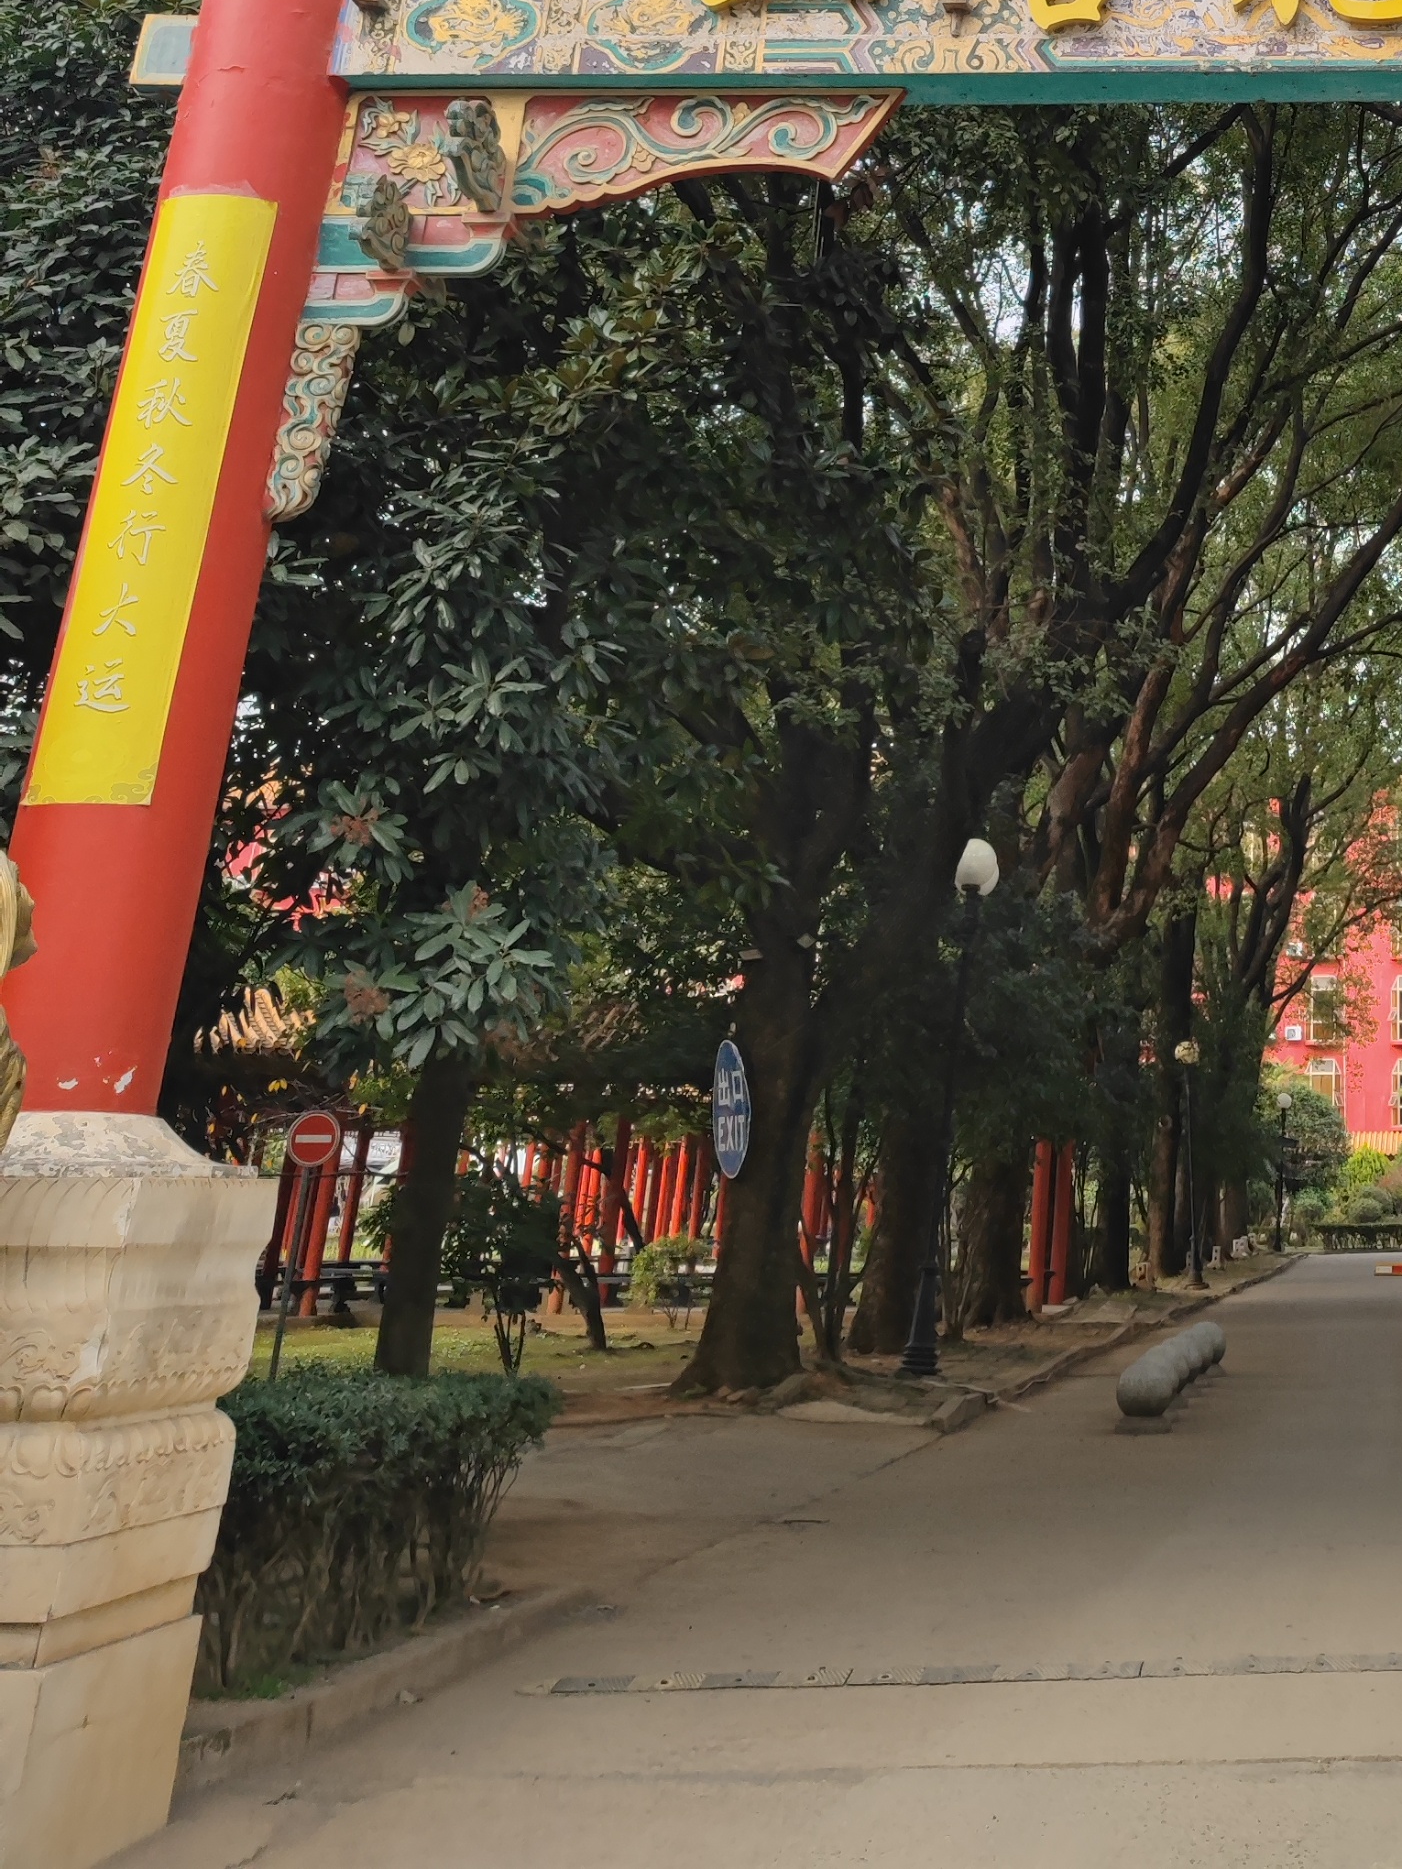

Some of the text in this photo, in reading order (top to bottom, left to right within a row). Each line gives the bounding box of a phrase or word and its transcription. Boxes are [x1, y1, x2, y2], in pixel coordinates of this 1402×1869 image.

[74, 241, 218, 713] 春夏秋冬行大运
[718, 1067, 744, 1107] 出口
[718, 1115, 745, 1151] EXIT
